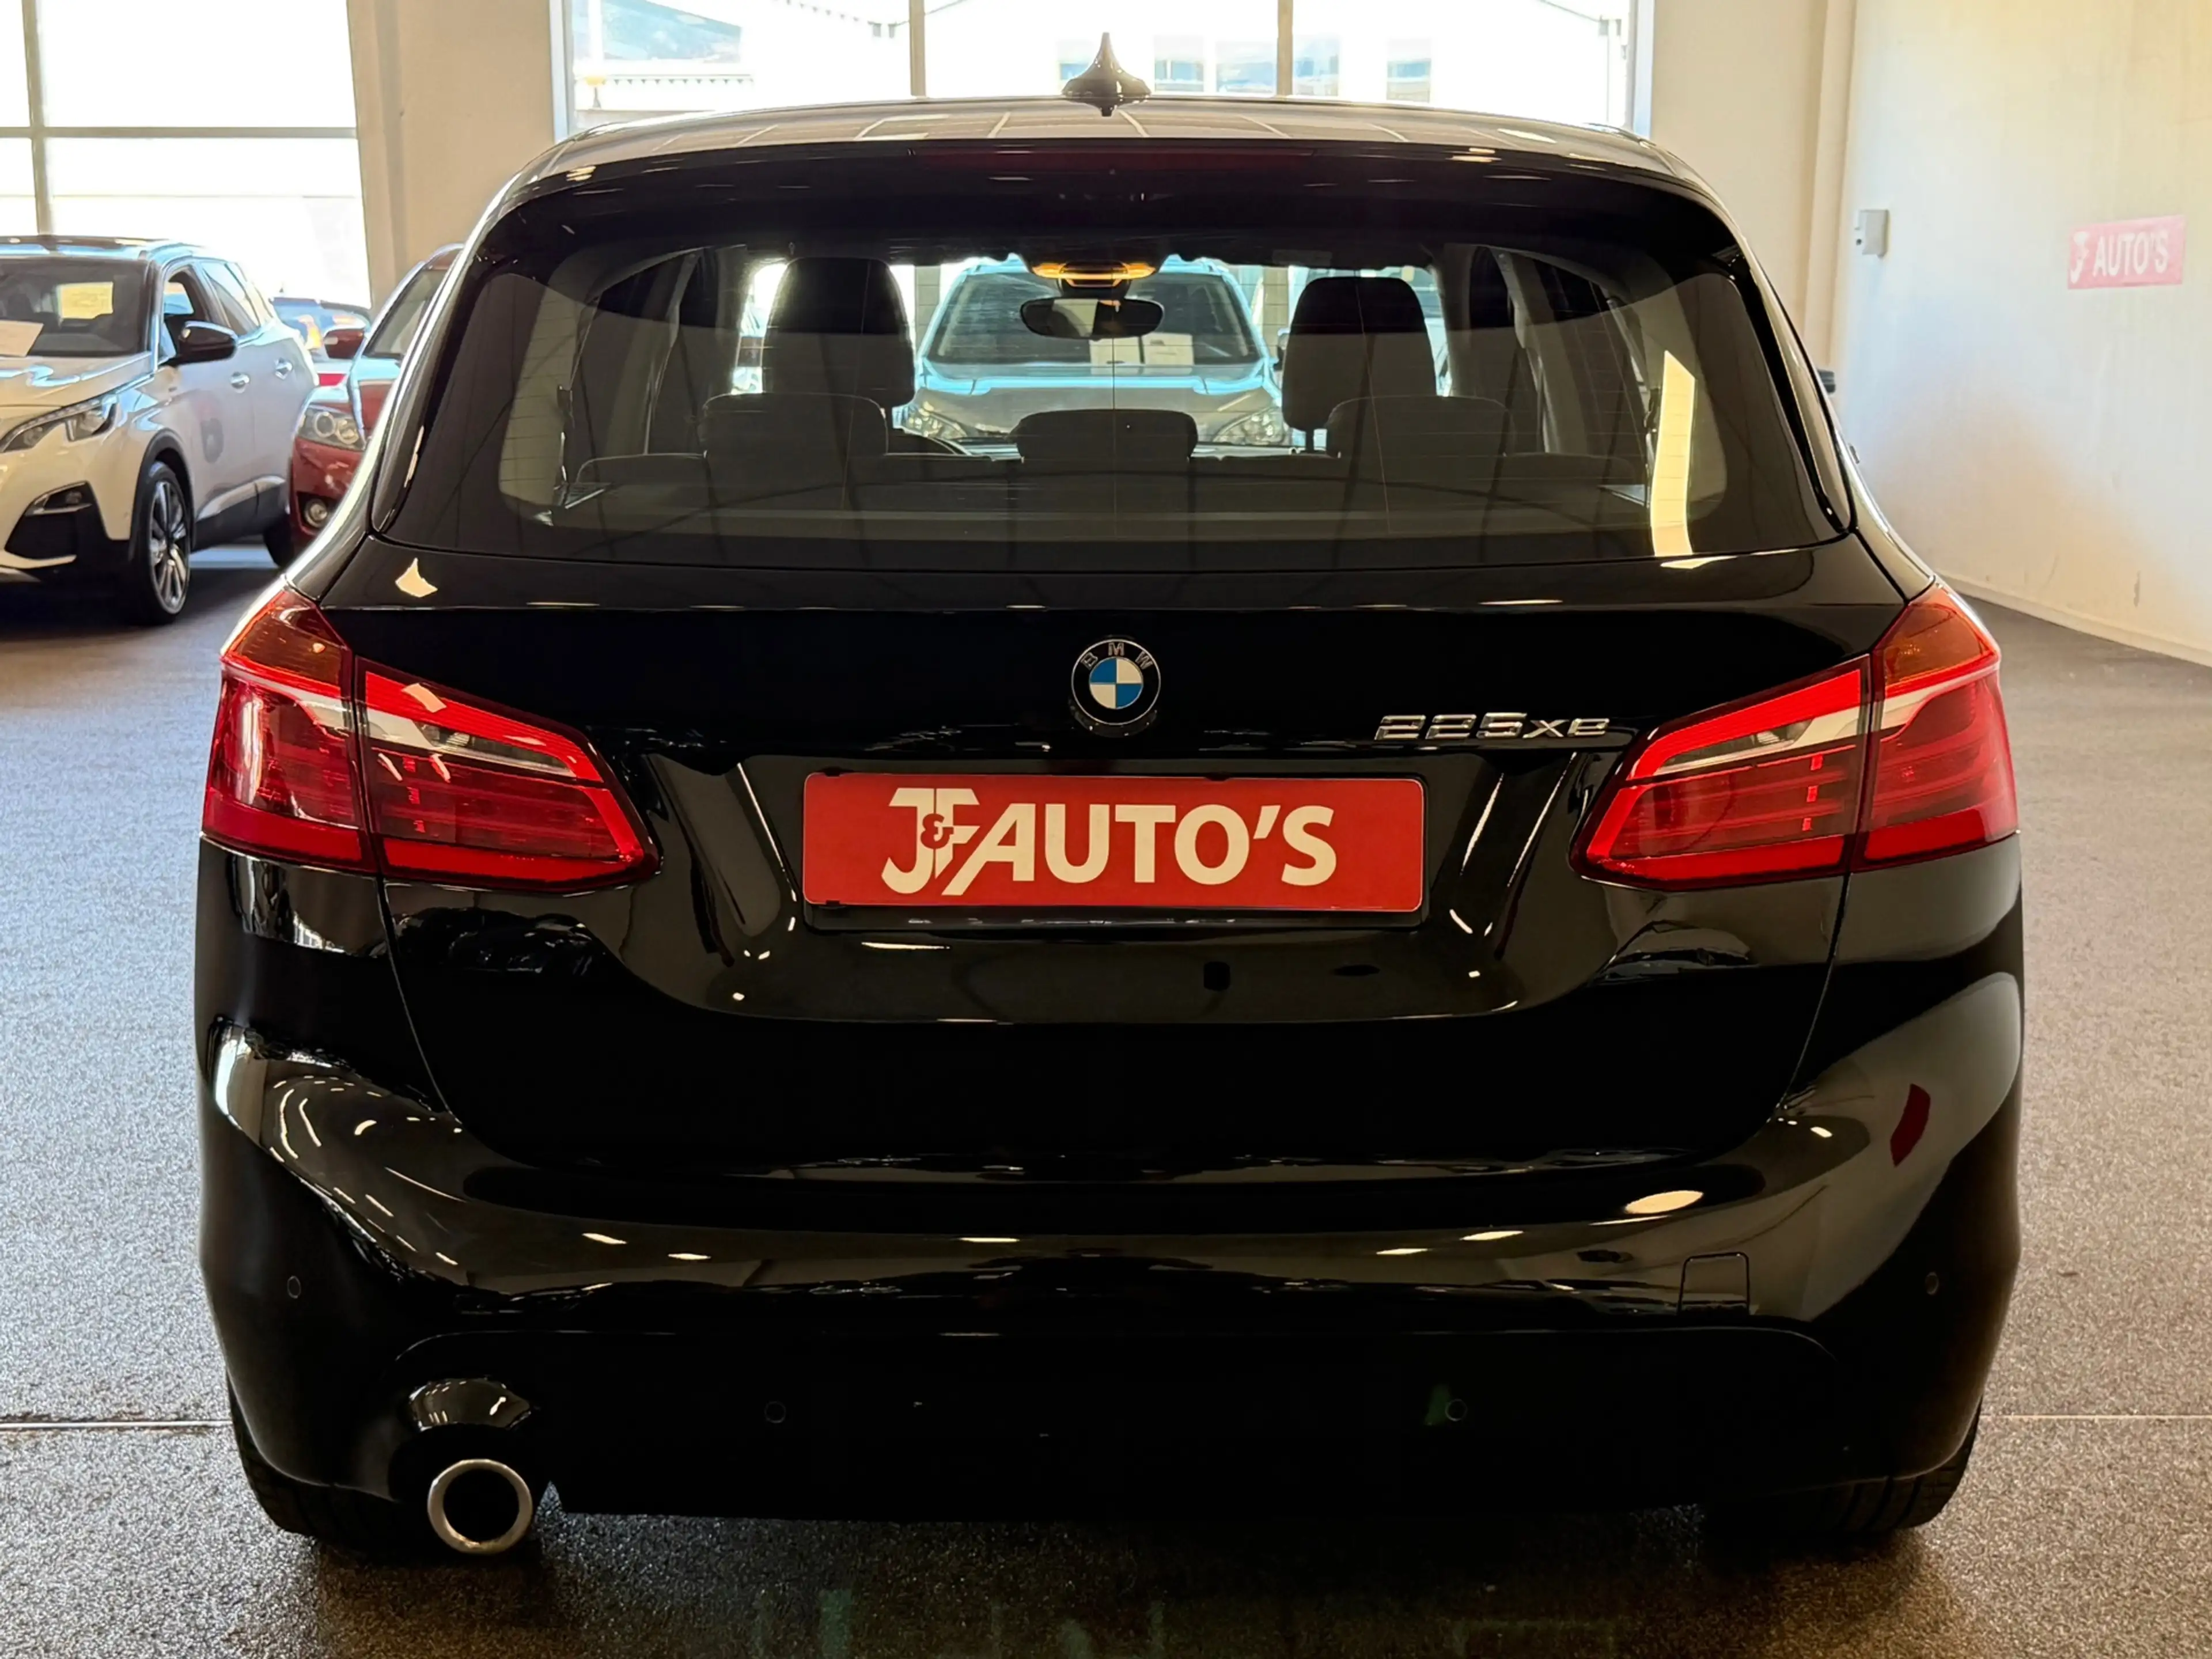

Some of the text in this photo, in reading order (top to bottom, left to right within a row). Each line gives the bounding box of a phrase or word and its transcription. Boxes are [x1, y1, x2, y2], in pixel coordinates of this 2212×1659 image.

[2092, 229, 2169, 277] AUTO'S
[1080, 642, 1153, 671] BMW
[941, 803, 1338, 896] AUTO'S
